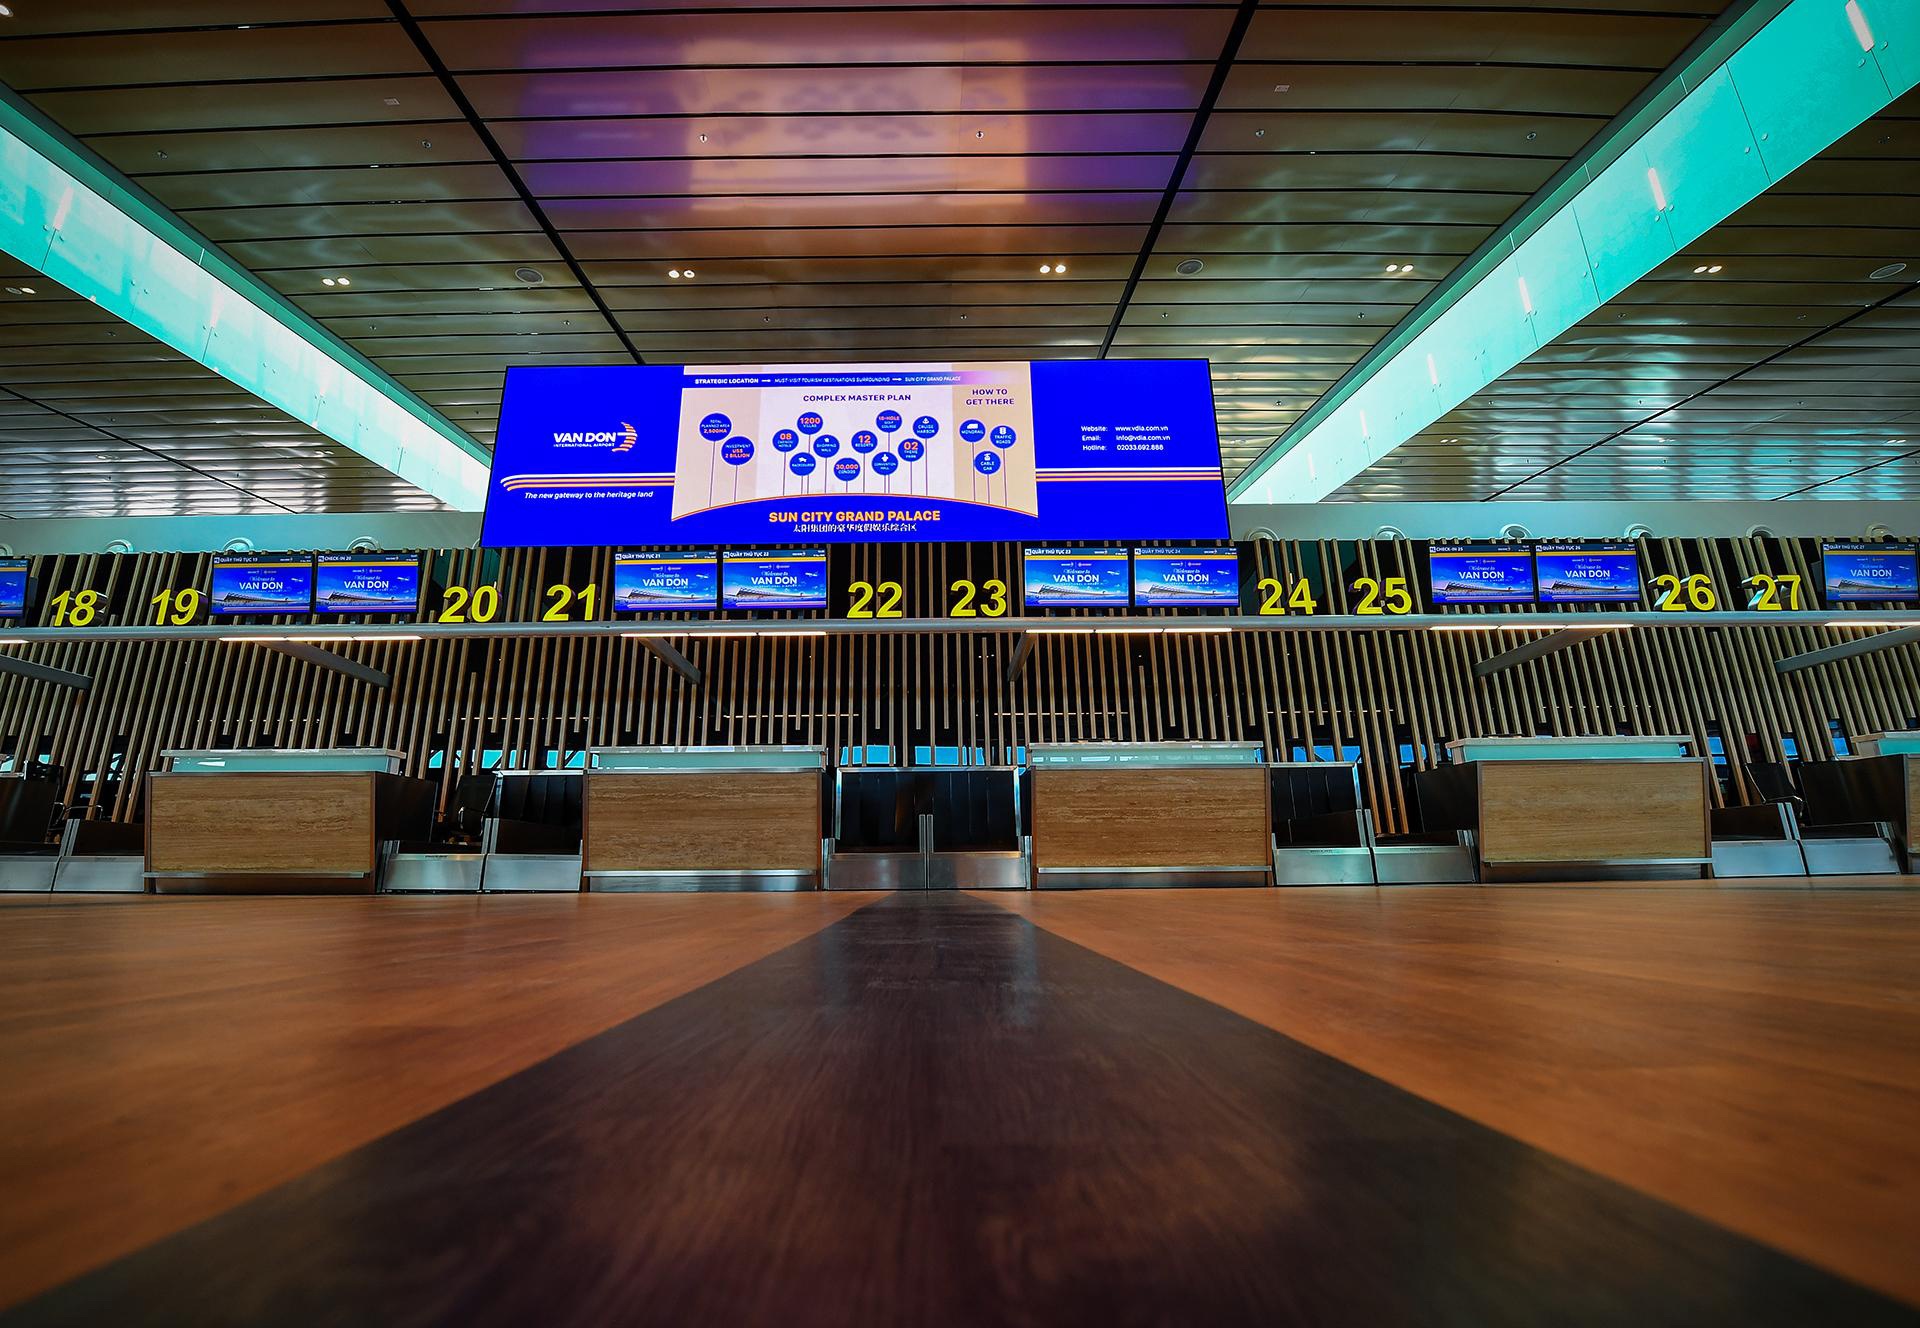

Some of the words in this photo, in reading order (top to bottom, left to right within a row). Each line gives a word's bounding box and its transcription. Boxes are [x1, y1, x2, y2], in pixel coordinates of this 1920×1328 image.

[553, 432, 583, 442] VAN
[585, 432, 617, 442] DON
[859, 435, 871, 443] 12
[904, 442, 918, 450] 02
[769, 512, 798, 522] SUN
[801, 512, 833, 522] CITY
[836, 511, 884, 522] GRAND
[888, 510, 941, 521] PALACE
[52, 589, 97, 626] 18
[152, 588, 199, 626] 19
[438, 585, 499, 623] 20
[543, 584, 596, 621] 21
[847, 581, 903, 618] 22
[950, 579, 1007, 617] 23
[1257, 577, 1317, 615] 24
[1354, 577, 1412, 614] 25
[1657, 574, 1716, 611] 26
[1752, 574, 1801, 611] 27
